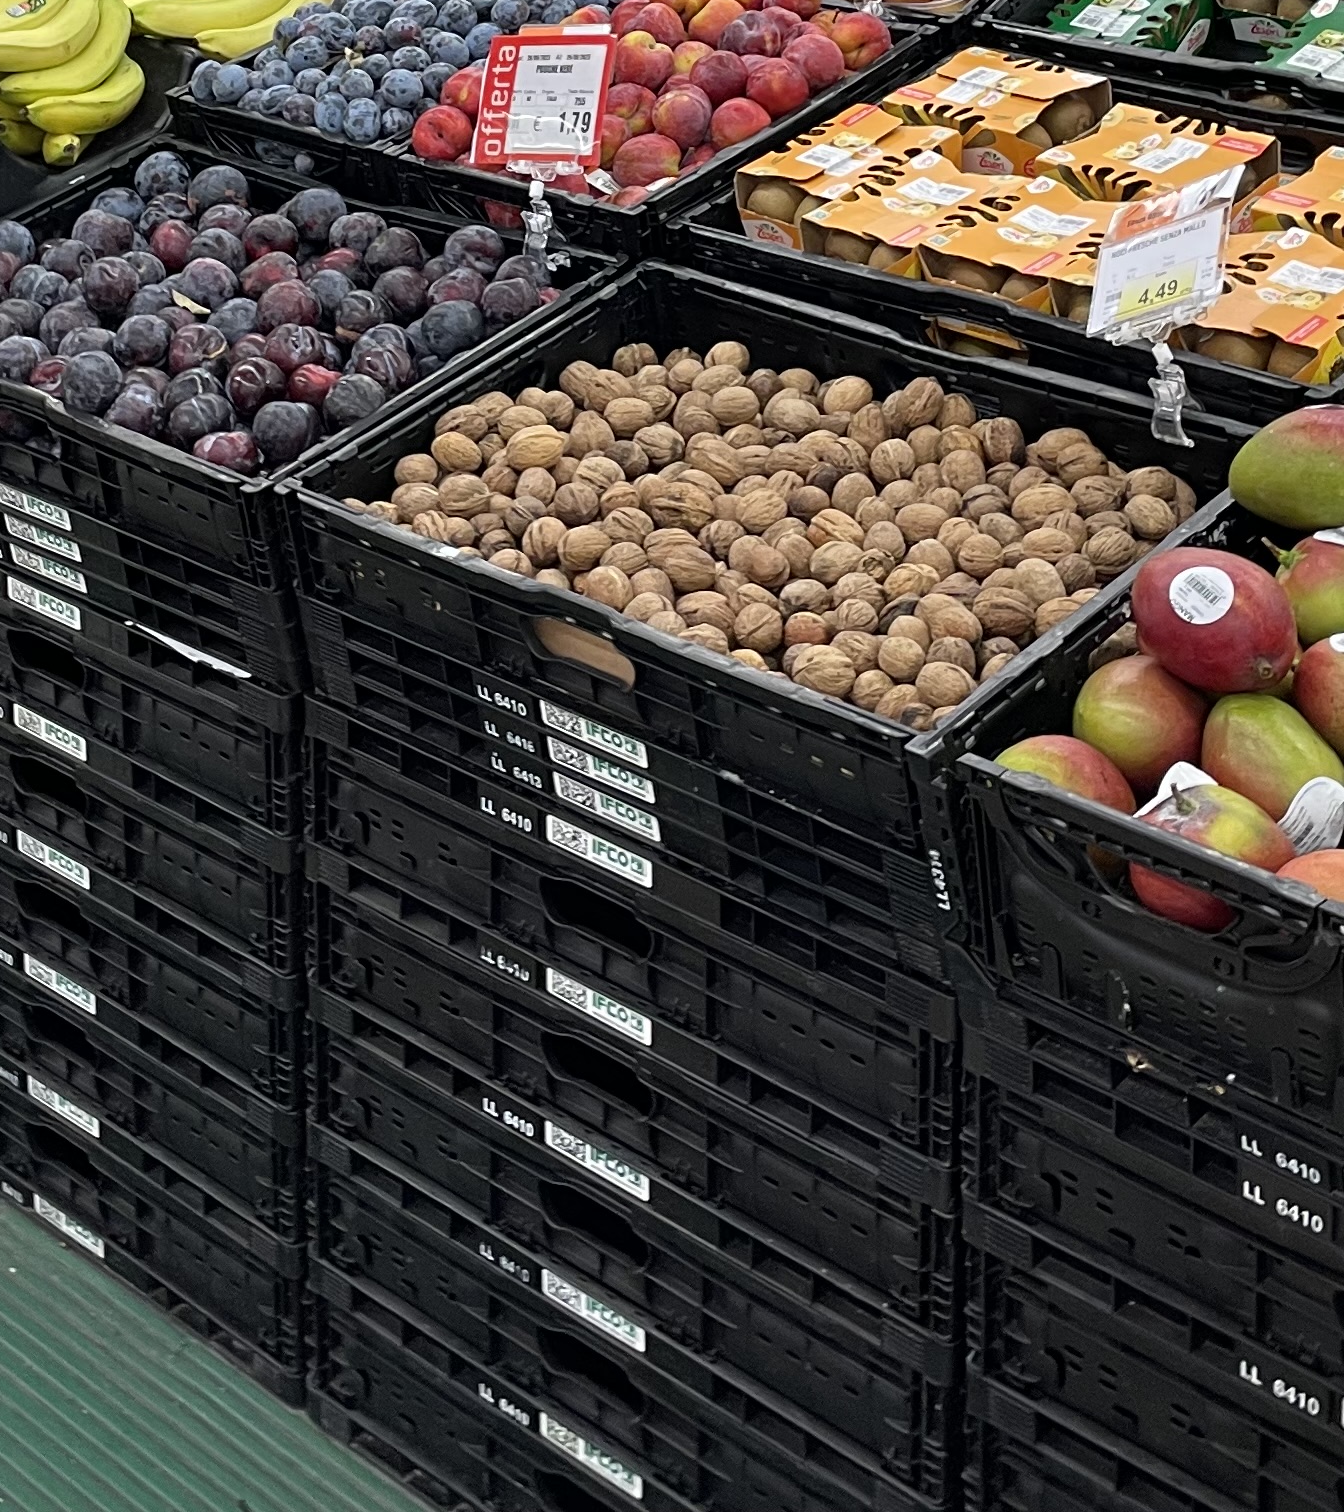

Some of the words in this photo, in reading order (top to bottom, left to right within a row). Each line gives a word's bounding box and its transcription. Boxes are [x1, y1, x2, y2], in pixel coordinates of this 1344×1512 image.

[481, 45, 517, 156] offerta
[560, 111, 592, 135] 1,79
[1138, 279, 1178, 305] 4,49
[26, 495, 53, 518] IFCO
[39, 591, 64, 615] IFCO
[476, 684, 493, 702] LL
[494, 692, 527, 717] 6410
[585, 720, 623, 747] IFCO
[592, 757, 629, 784] IFCO
[480, 796, 496, 816] LL
[501, 808, 532, 833] 6410
[599, 794, 638, 822] IFCO
[592, 839, 630, 867] IFCO
[591, 992, 629, 1024] IFCO
[1241, 1135, 1263, 1157] LL
[1275, 1152, 1321, 1184] 6410
[1242, 1180, 1265, 1206] LL
[1276, 1198, 1324, 1233] 6410
[1239, 1360, 1263, 1386] LL
[1273, 1379, 1320, 1416] 6410
